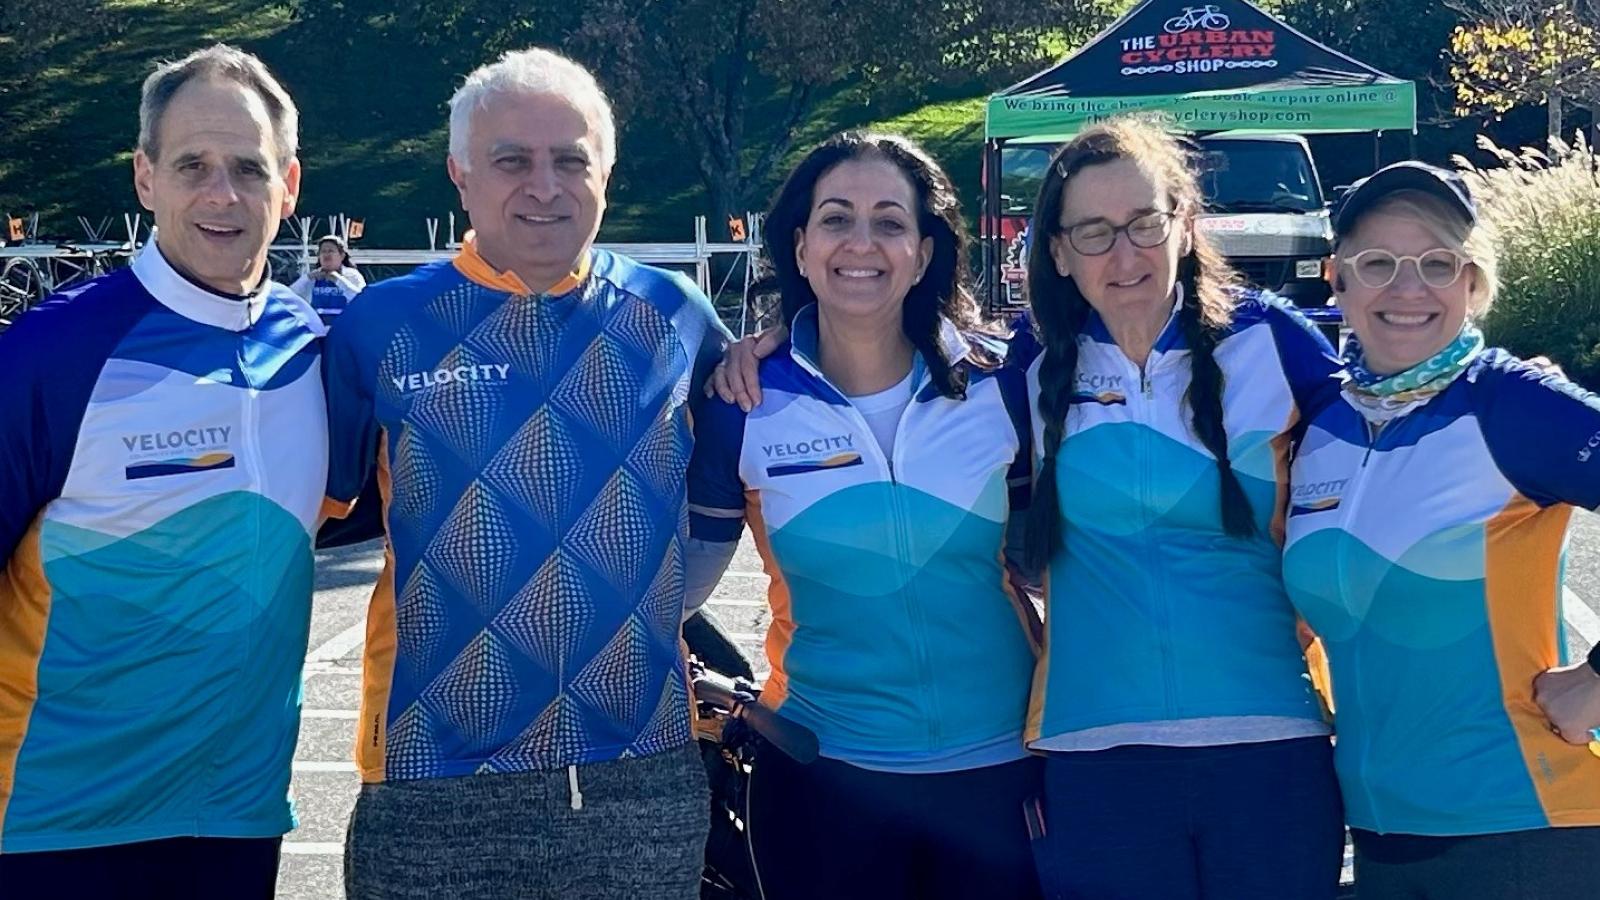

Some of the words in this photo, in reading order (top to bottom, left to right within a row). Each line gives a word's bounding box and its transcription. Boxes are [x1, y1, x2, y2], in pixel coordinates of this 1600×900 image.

[1120, 36, 1155, 51] THE
[1158, 30, 1275, 48] URBAN
[1120, 44, 1276, 64] CYCLERY
[1174, 59, 1224, 73] SHOP
[1004, 98, 1028, 111] We
[1032, 99, 1076, 113] bring
[1081, 100, 1105, 112] the
[1271, 91, 1321, 106] repair
[1326, 90, 1378, 104] online
[1384, 88, 1398, 102] @
[731, 224, 742, 236] K
[391, 363, 510, 393] VELOCITY
[122, 426, 232, 452] VELOCITY
[762, 433, 853, 457] VELOCITY
